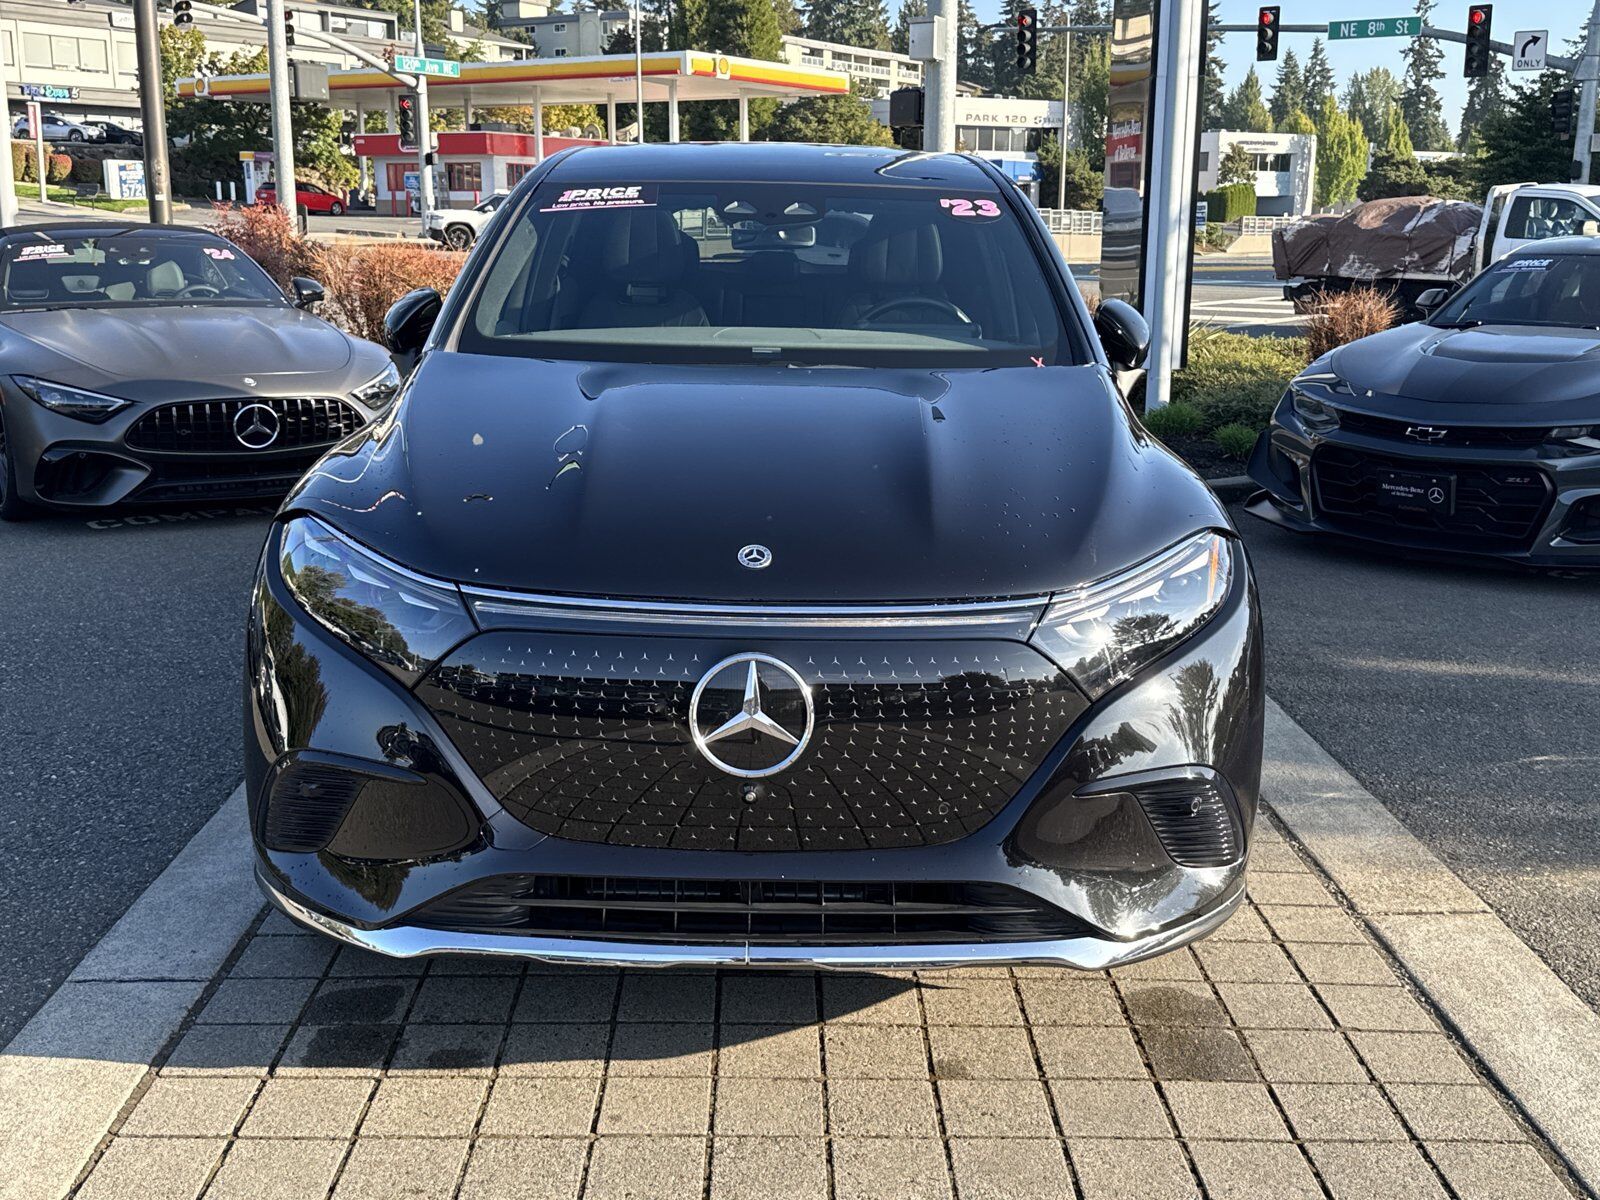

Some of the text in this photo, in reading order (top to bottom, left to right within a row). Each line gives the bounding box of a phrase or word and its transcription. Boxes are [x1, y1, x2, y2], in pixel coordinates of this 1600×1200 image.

[1340, 19, 1409, 37] NE 8th St
[403, 58, 455, 74] 120th Ave NE
[1516, 58, 1541, 68] ONLY
[965, 113, 999, 122] PARK
[1005, 115, 1027, 124] 120
[939, 198, 1001, 217] '23
[1381, 483, 1424, 493] Mercedes-Benz
